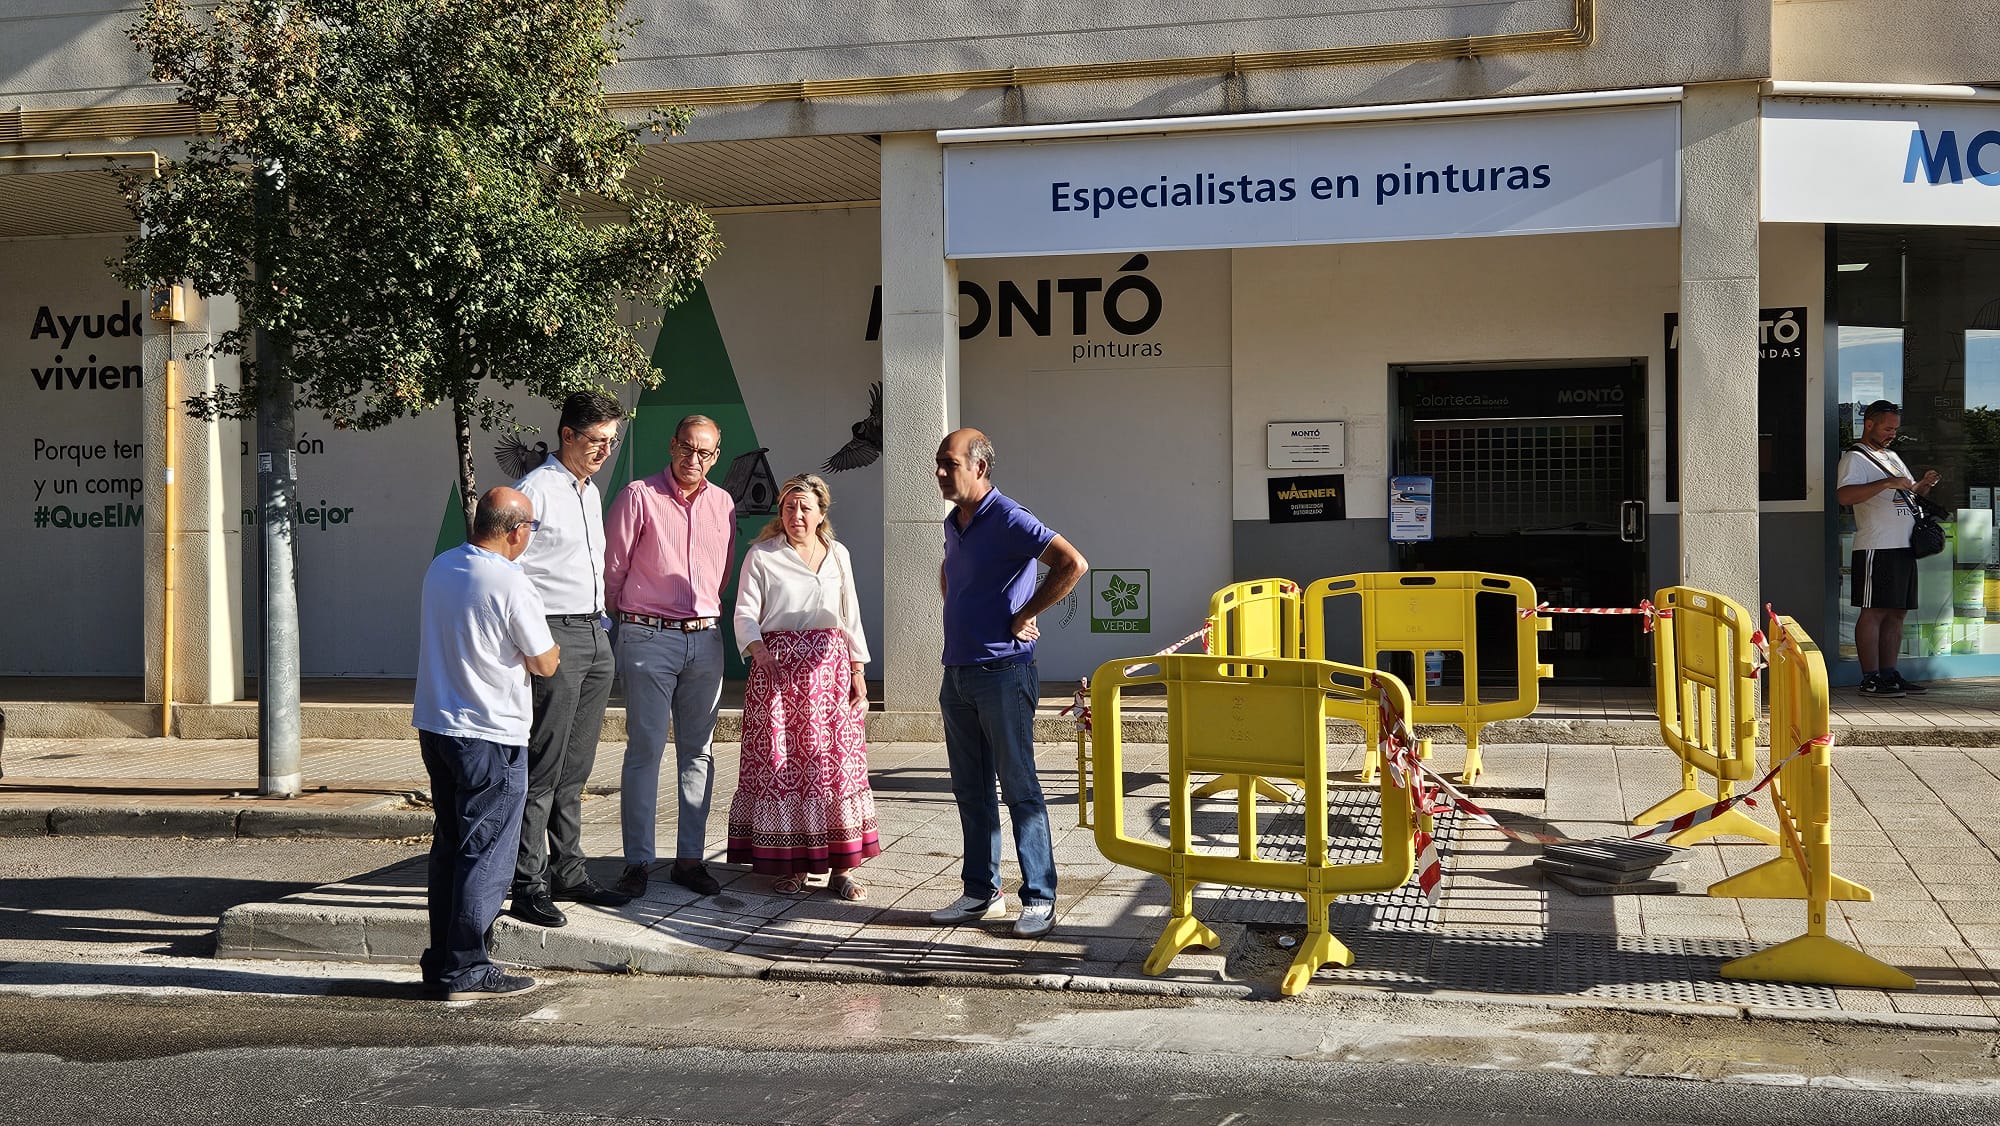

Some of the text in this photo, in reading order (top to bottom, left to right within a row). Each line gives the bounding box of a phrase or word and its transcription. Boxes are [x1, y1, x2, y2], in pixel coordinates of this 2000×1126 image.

[1903, 130, 2000, 186] MO
[1052, 163, 1551, 218] Especialistas en pinturas
[865, 253, 1163, 341] ONTÓ
[1072, 339, 1163, 362] pinturas
[1758, 347, 1801, 359] NDAS
[30, 354, 143, 391] vivien
[1558, 384, 1624, 404] MONTÓ
[1291, 429, 1320, 437] MONTÓ
[34, 438, 143, 467] Porque ten
[33, 478, 143, 502] y un comp
[1277, 481, 1337, 500] WAGNER
[1102, 621, 1139, 631] VERDE
